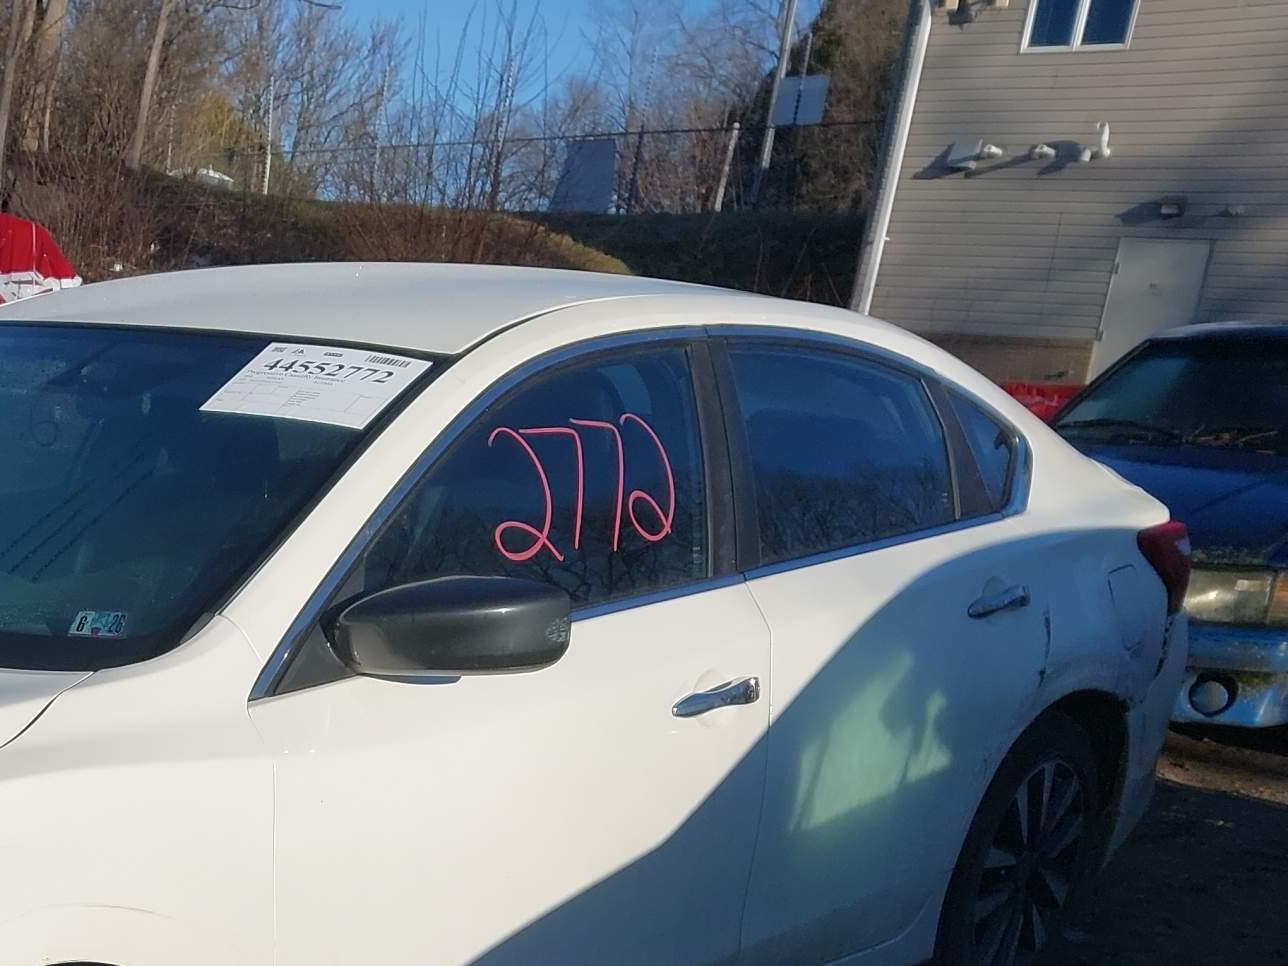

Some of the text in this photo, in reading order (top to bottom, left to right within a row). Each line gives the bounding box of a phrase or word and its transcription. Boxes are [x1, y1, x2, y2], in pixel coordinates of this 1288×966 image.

[263, 358, 394, 384] 44552772
[488, 413, 675, 561] 2772
[76, 615, 88, 632] 6
